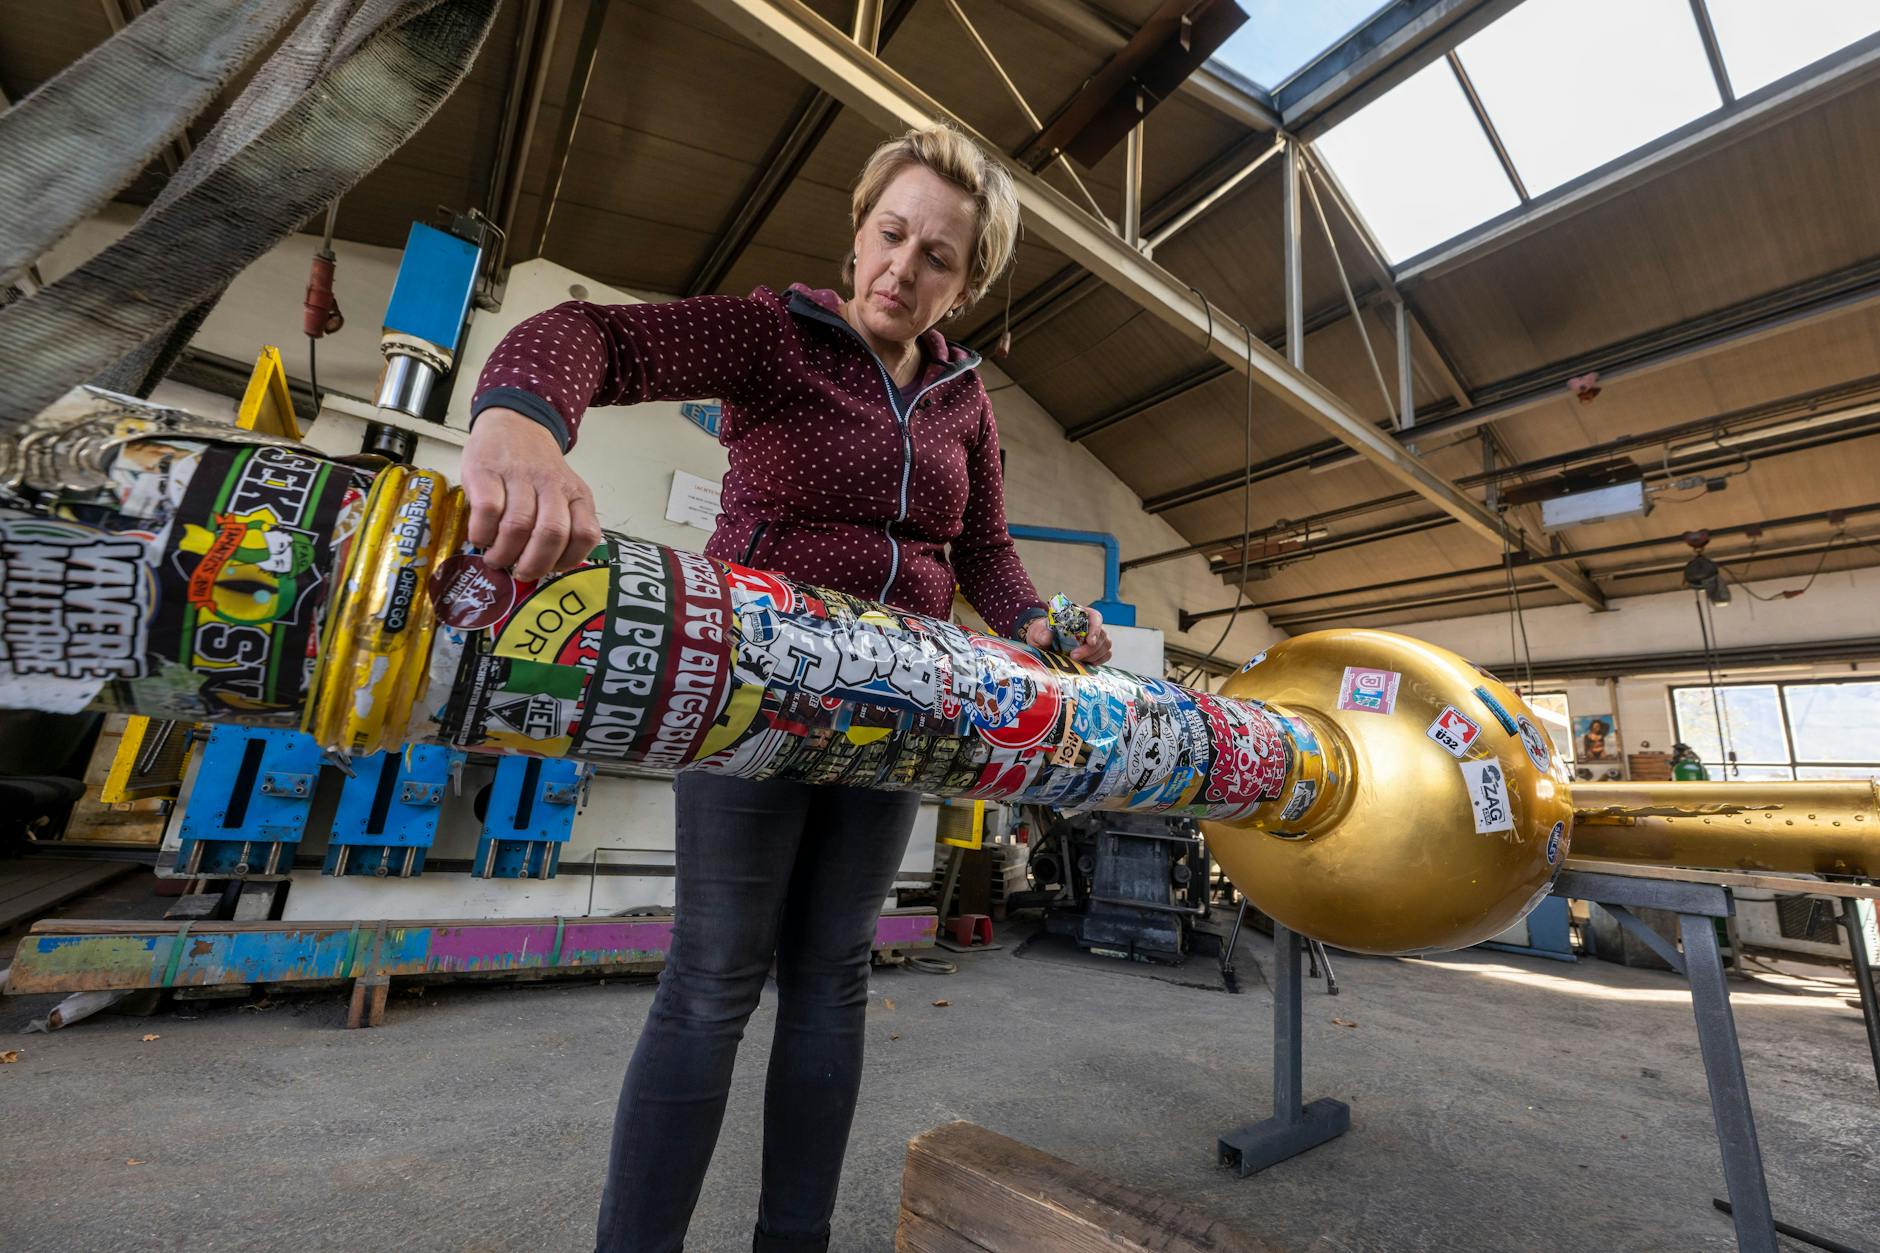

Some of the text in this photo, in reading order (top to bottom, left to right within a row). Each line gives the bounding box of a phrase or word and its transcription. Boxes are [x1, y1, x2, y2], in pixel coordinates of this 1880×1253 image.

[229, 447, 319, 527] SEK
[672, 549, 722, 600] ORZA
[515, 590, 588, 657] DOR
[684, 605, 722, 644] FC
[601, 617, 666, 697] PER
[527, 696, 558, 738] HEC
[934, 689, 943, 720] EMPIRE
[1183, 709, 1200, 740] SECHS
[1435, 728, 1459, 751] Ü32
[1482, 784, 1503, 824] ZAG
[1548, 825, 1563, 860] SMILEY
